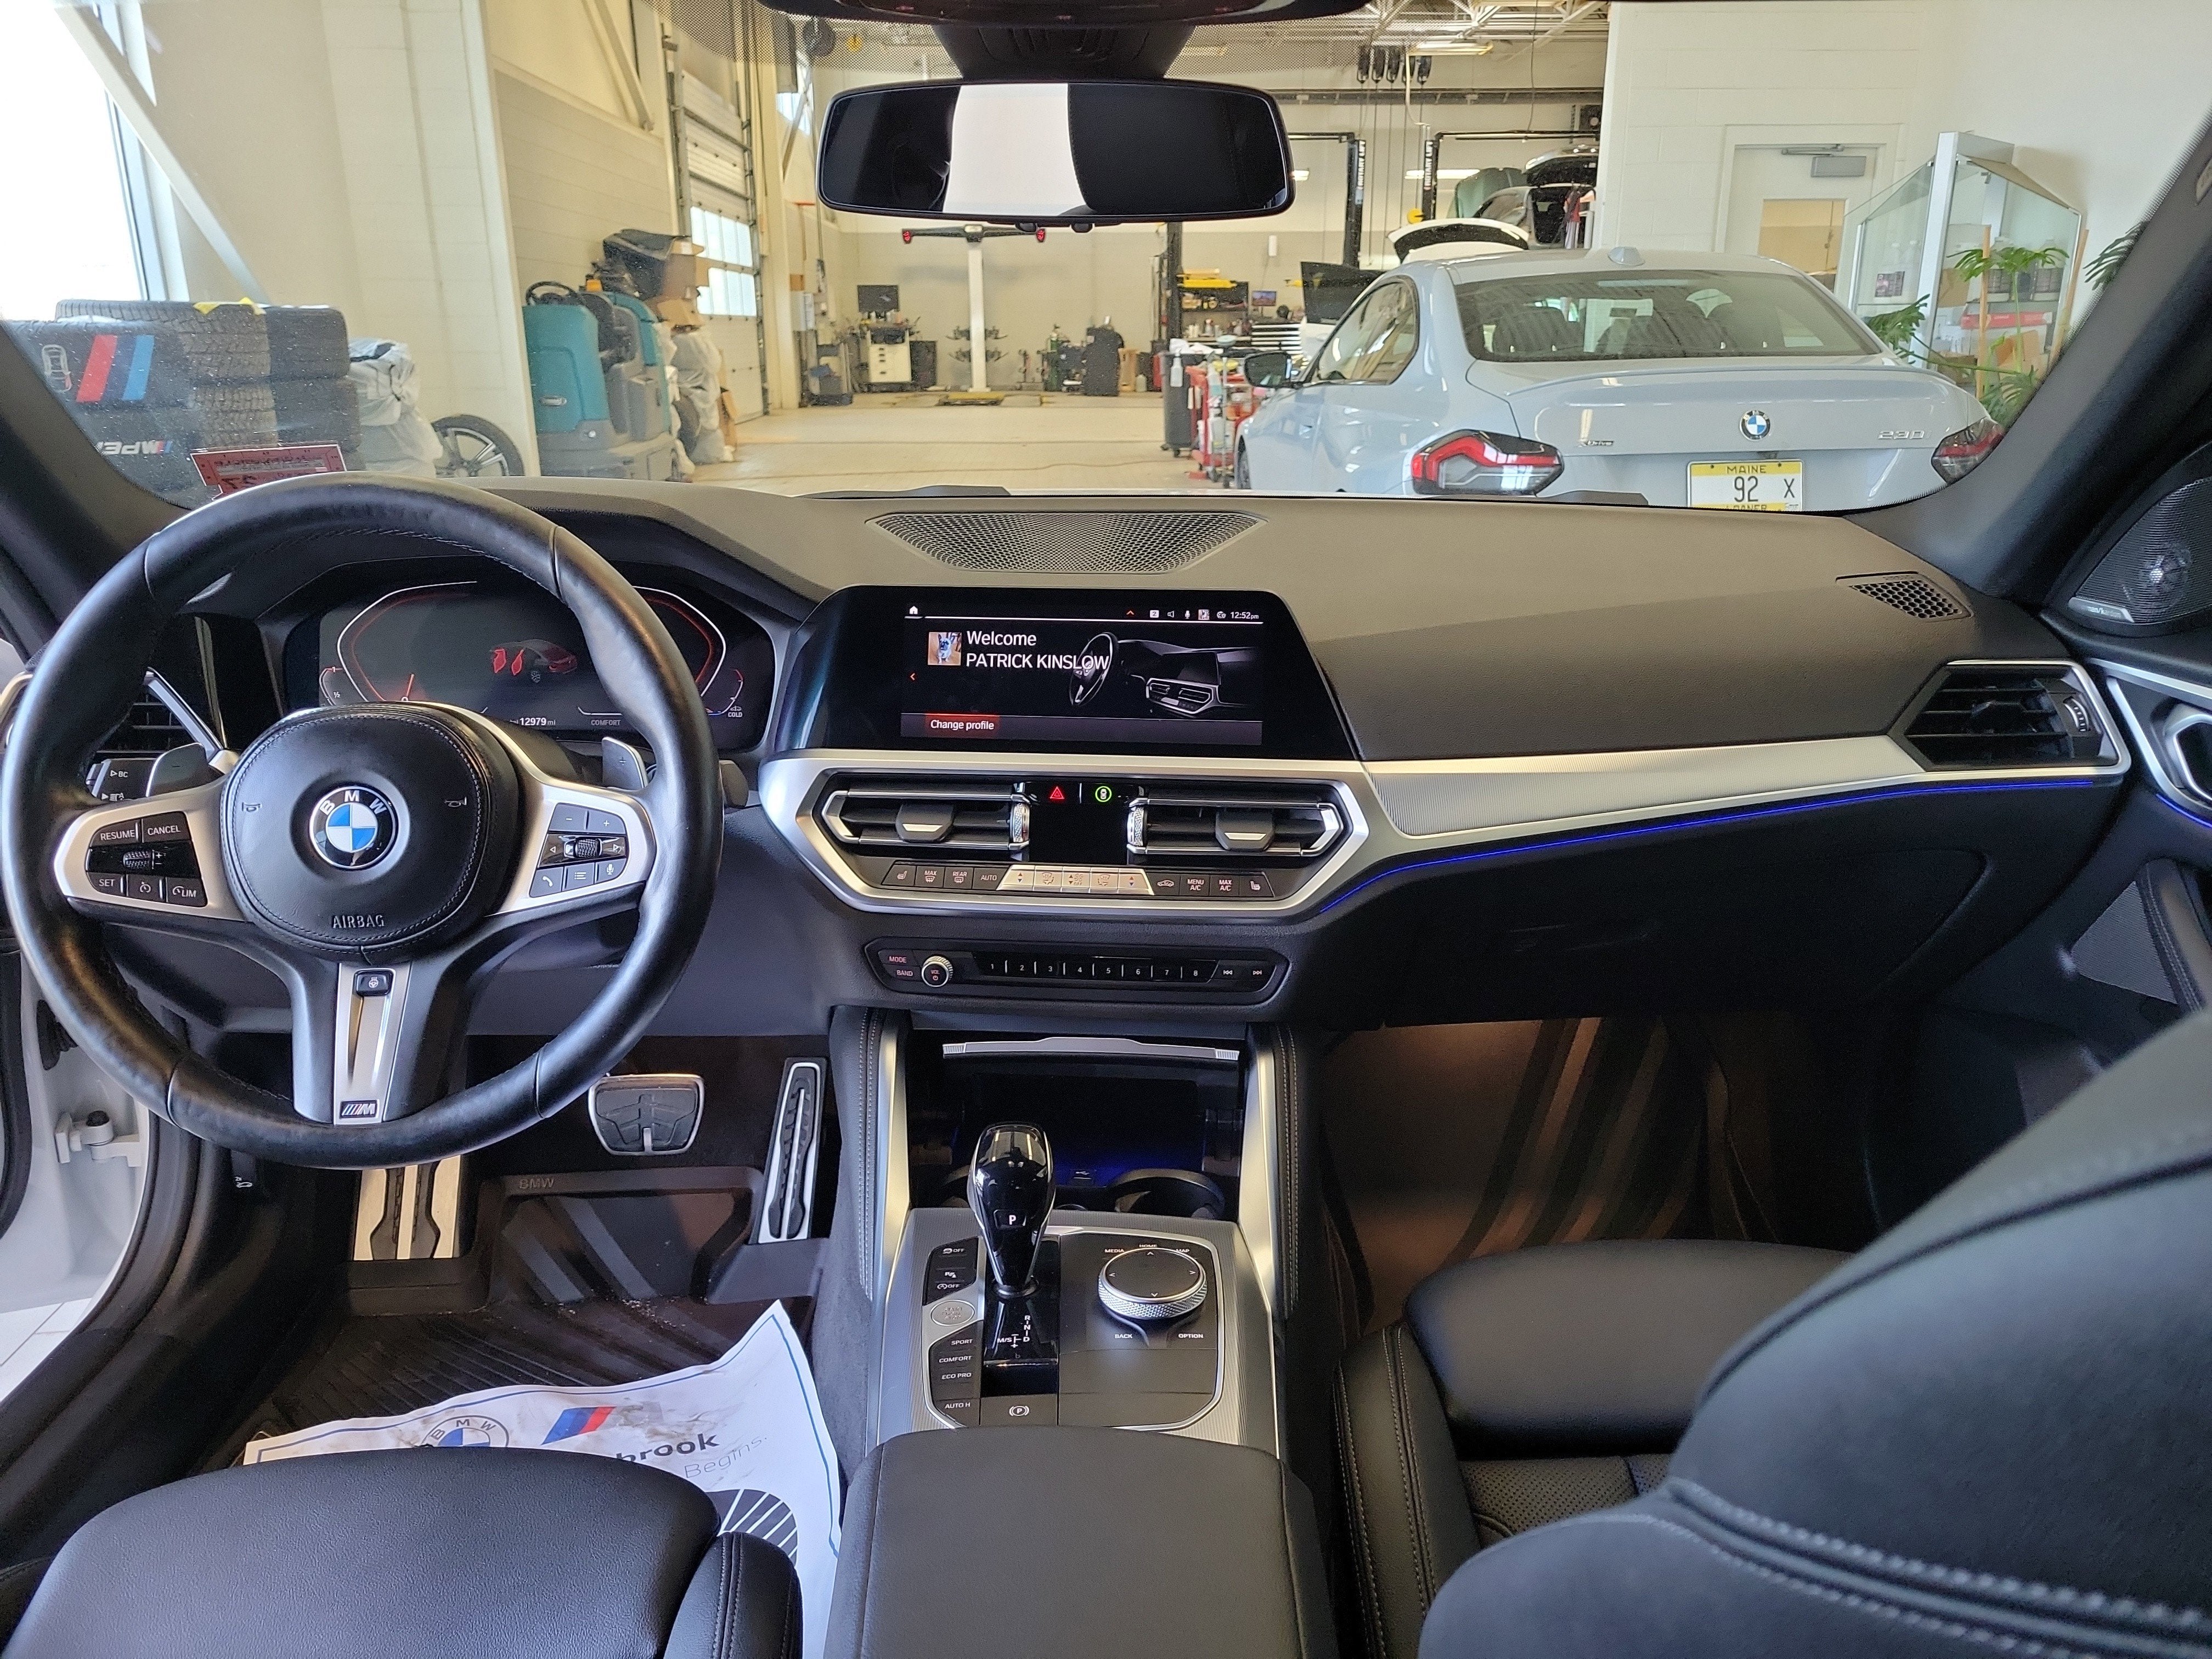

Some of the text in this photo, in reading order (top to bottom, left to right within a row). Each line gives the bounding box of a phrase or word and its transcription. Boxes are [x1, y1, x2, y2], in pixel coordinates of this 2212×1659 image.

[1726, 465, 1767, 474] MAINE
[1734, 476, 1795, 503] 92 X
[1231, 611, 1259, 620] 12:52pm
[966, 630, 1037, 646] Welcome
[966, 653, 1110, 670] PATRICK KINSLOW
[520, 717, 546, 726] 12979
[930, 719, 995, 731] Change profile
[320, 790, 386, 815] BMW
[100, 830, 136, 841] RESUME
[147, 825, 180, 836] CANCEL
[99, 879, 115, 887] SET
[182, 889, 196, 898] LIM
[331, 915, 385, 929] AIRBAG
[1009, 1215, 1017, 1225] P
[939, 1355, 972, 1363] COMFORT
[430, 1419, 496, 1440] BMW
[684, 1437, 767, 1479] Begins.
